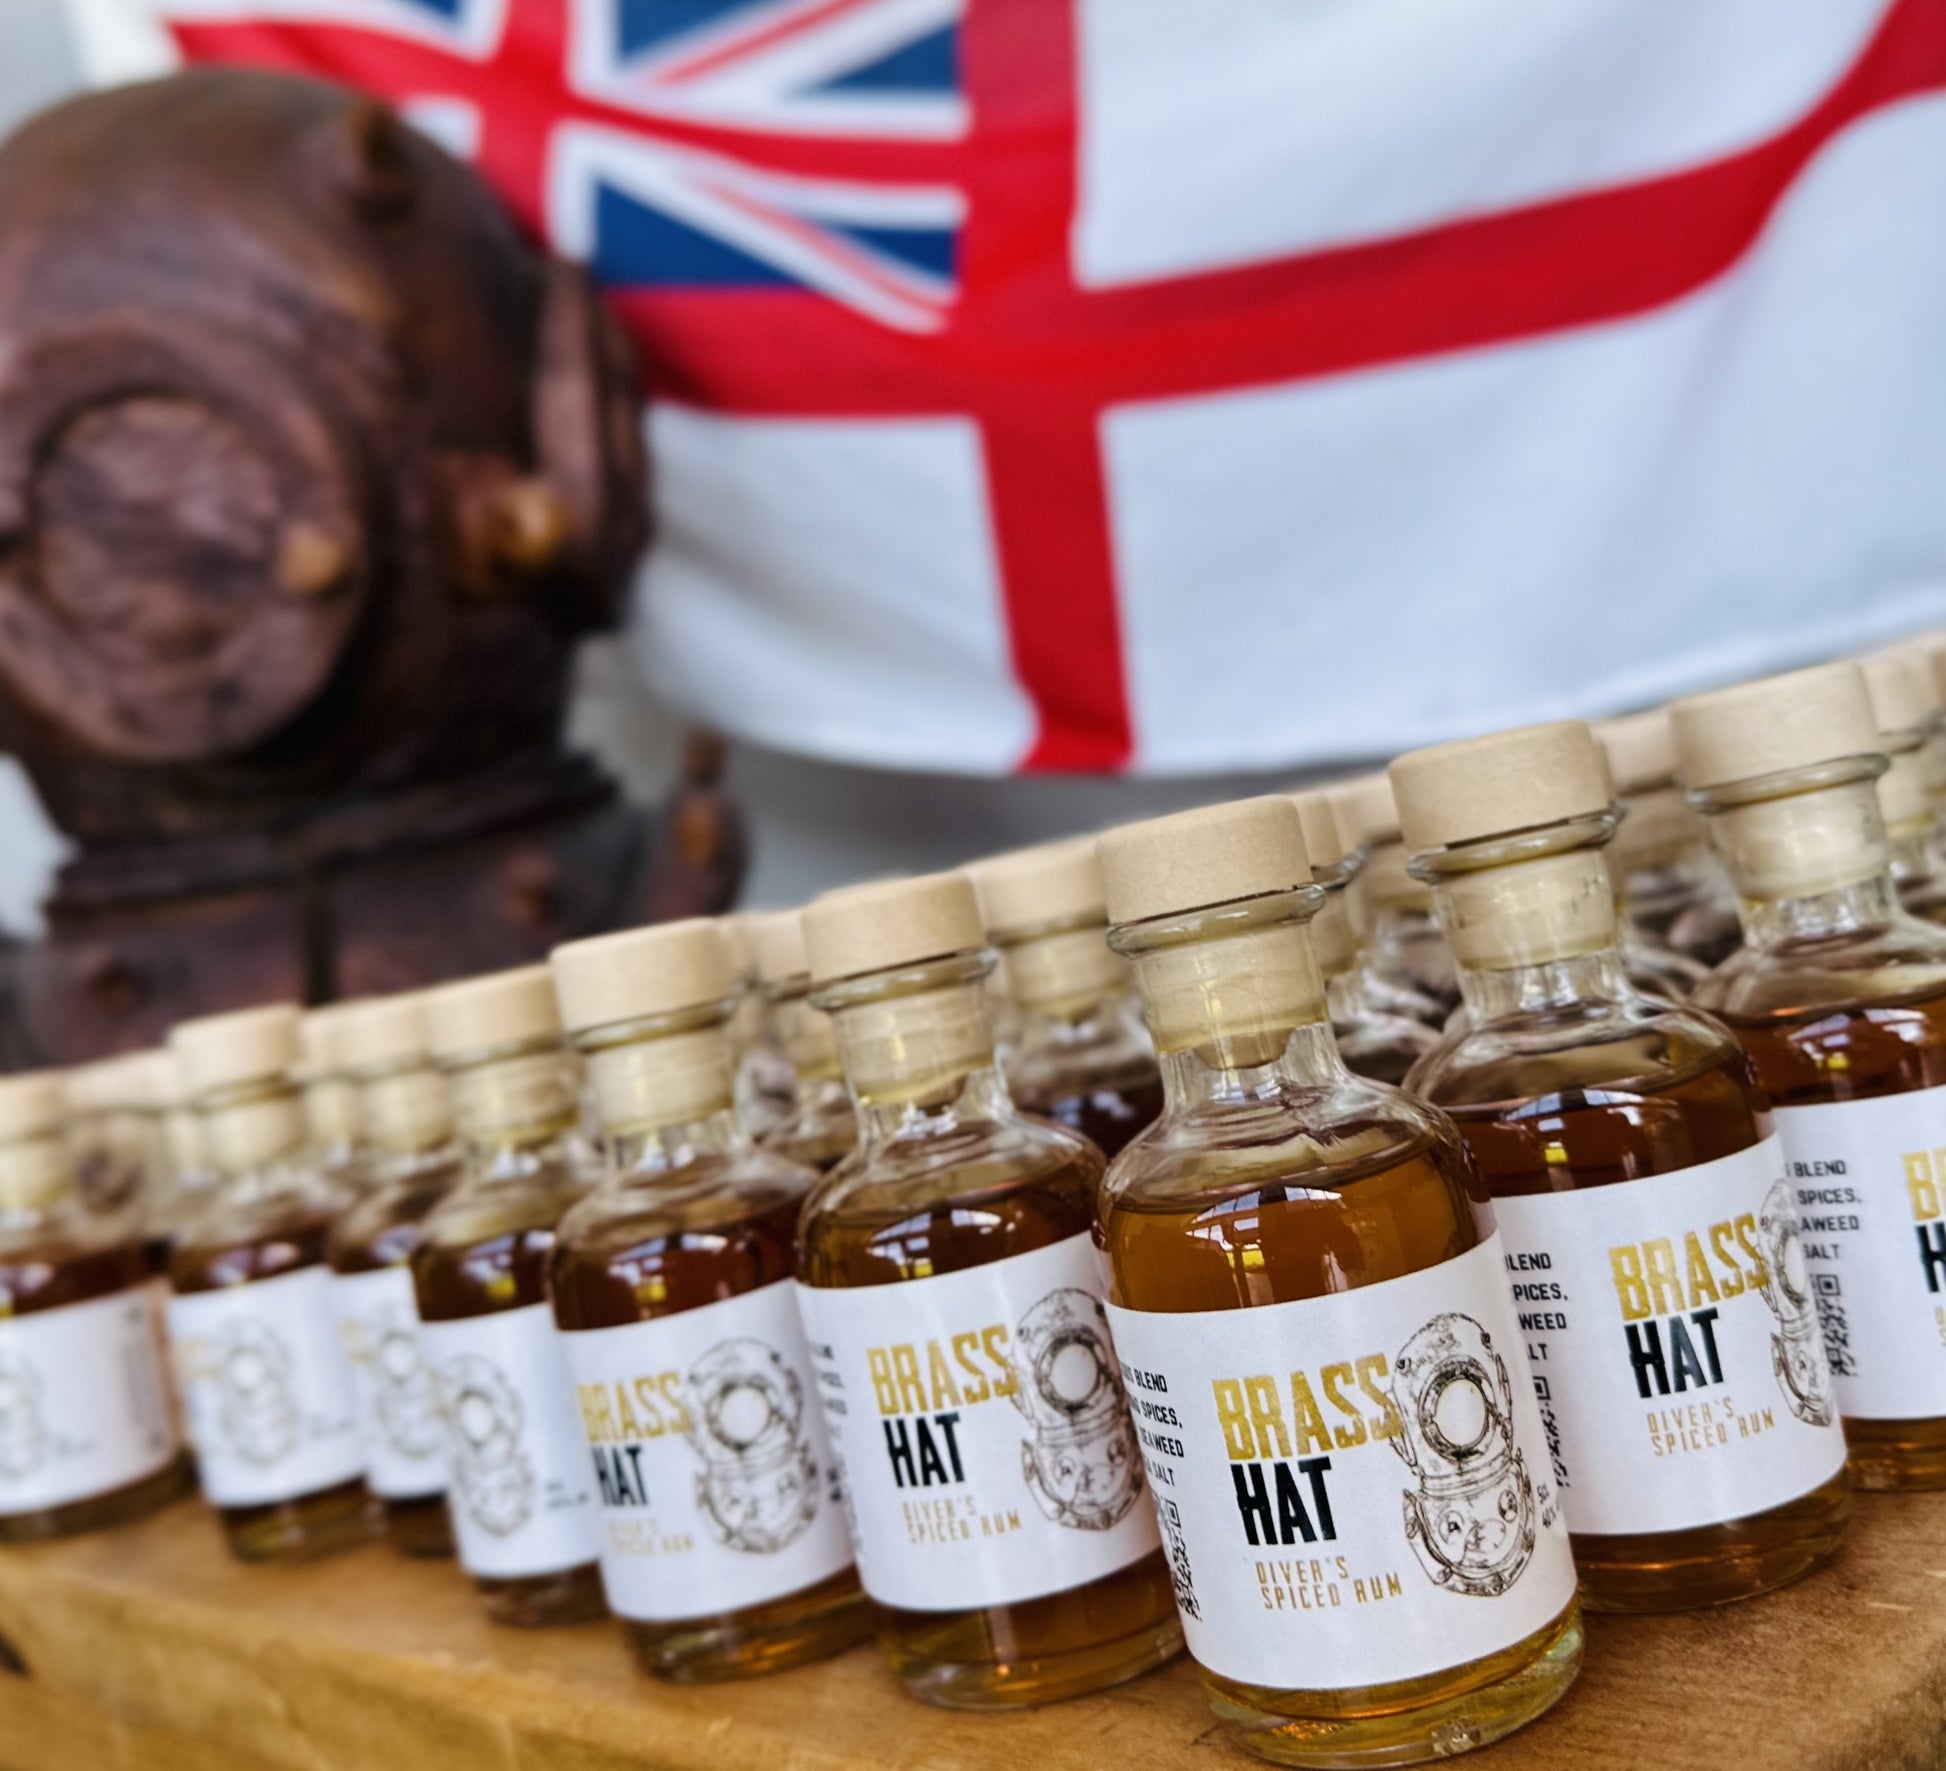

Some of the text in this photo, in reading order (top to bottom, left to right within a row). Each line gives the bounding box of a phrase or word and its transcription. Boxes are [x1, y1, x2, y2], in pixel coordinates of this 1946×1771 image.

[1793, 1160, 1846, 1177] BLEND
[1797, 1187, 1862, 1205] SPICES,
[1505, 1252, 1552, 1271] LEND
[1608, 1212, 1769, 1321] BRASS
[866, 1323, 1020, 1416] BRASS
[1527, 1343, 1547, 1360] LT
[1624, 1307, 1724, 1398] HAT
[1133, 1368, 1168, 1393] BLEND
[1140, 1400, 1183, 1429] SPICES,
[1211, 1353, 1402, 1460] BRASS
[1646, 1396, 1734, 1434] DIVER'S
[883, 1411, 965, 1488] HAT
[1651, 1406, 1774, 1456] SPICED RUM
[1151, 1461, 1175, 1487] SALT
[1230, 1456, 1337, 1546] HAT
[1255, 1555, 1349, 1585] DIVER'S
[1261, 1572, 1403, 1610] SPICED RUM
